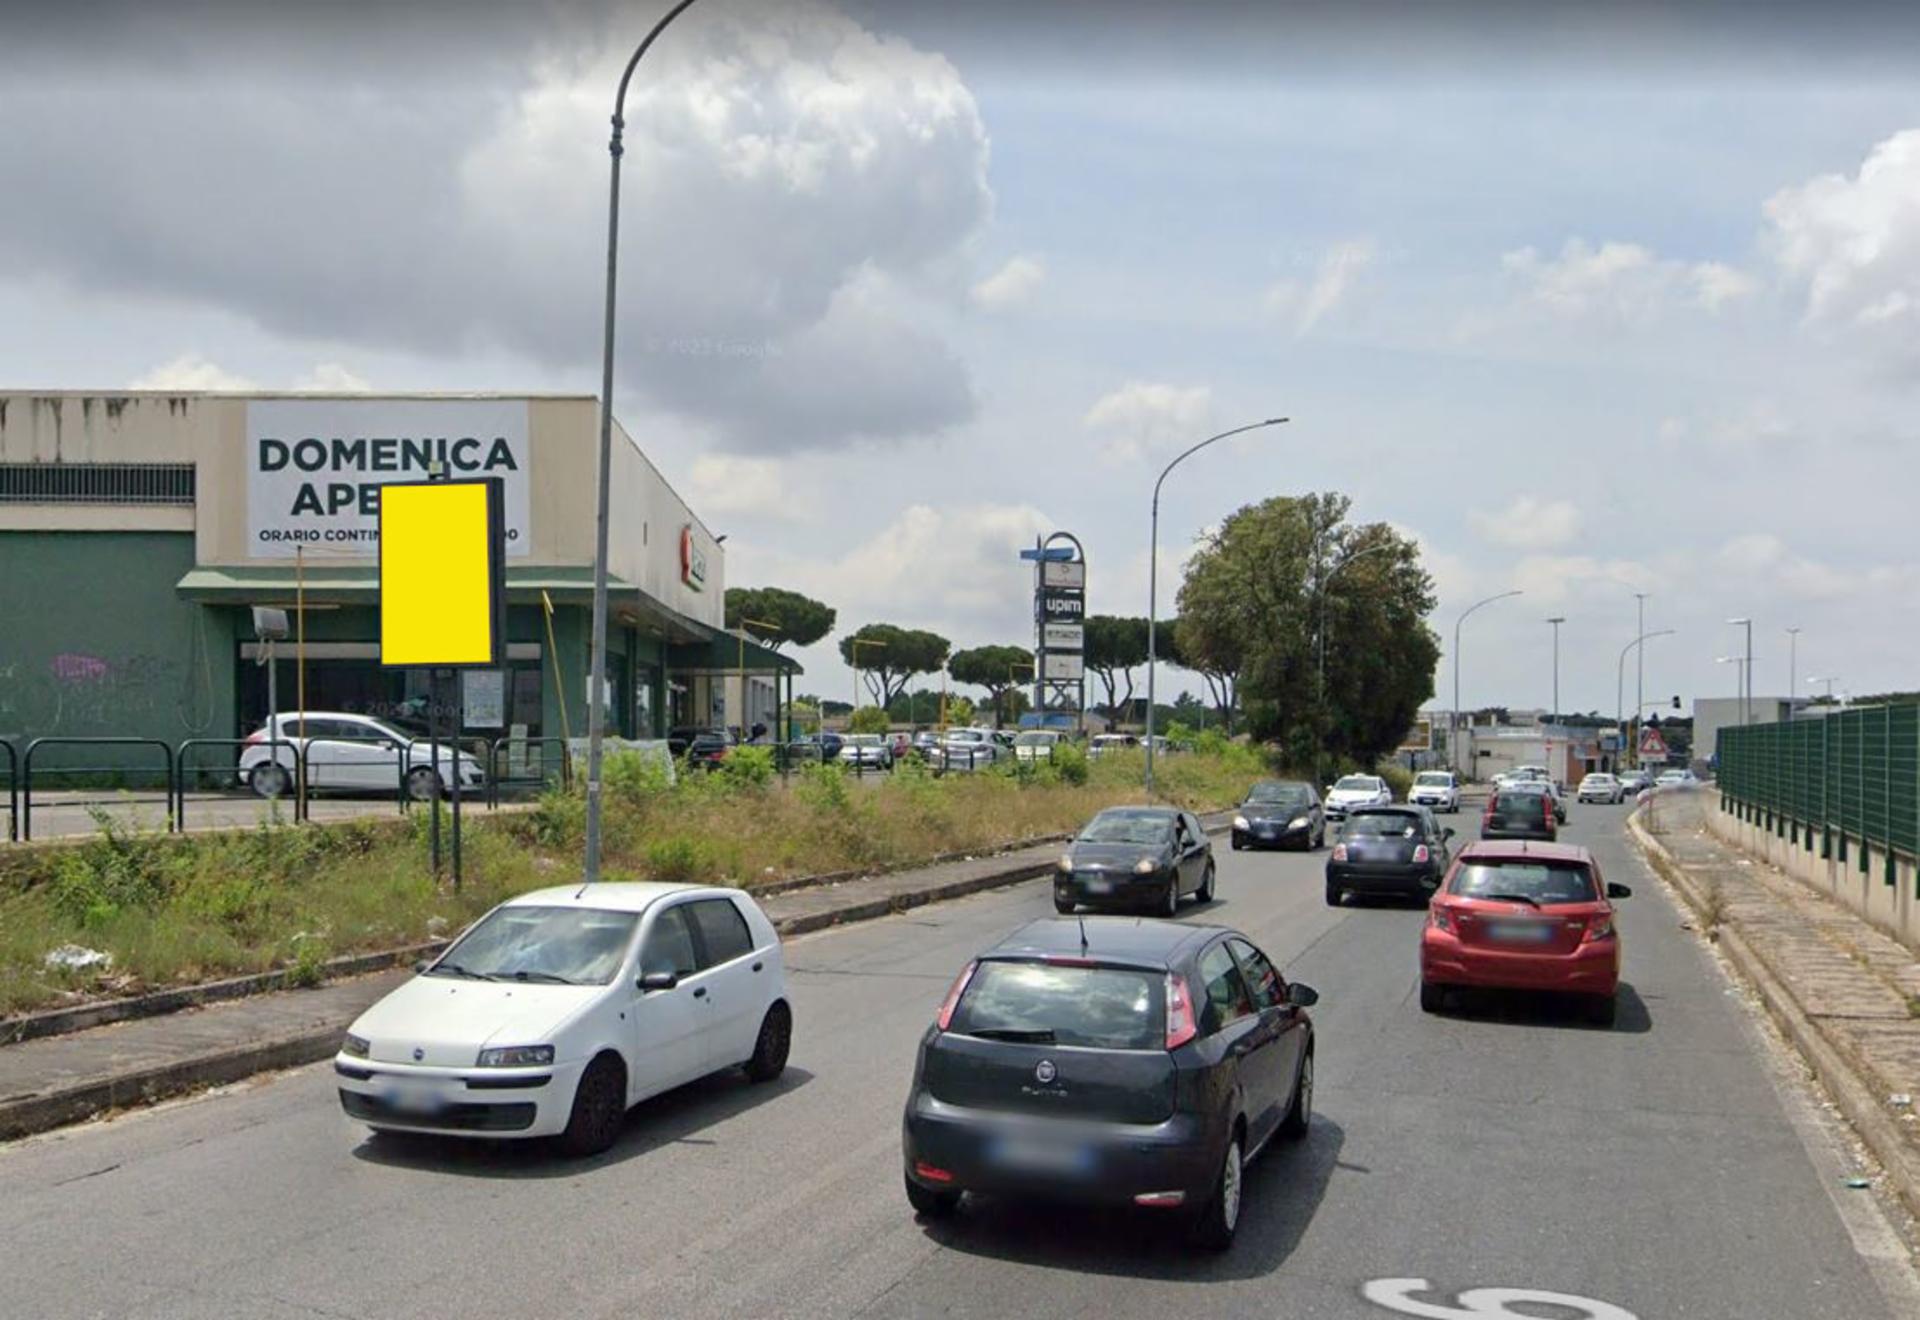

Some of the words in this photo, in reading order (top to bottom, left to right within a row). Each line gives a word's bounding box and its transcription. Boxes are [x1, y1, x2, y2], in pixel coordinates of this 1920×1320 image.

[259, 437, 518, 472] DOMENICA
[291, 483, 380, 515] APE
[259, 529, 320, 542] ORARIO
[1045, 598, 1082, 615] upim
